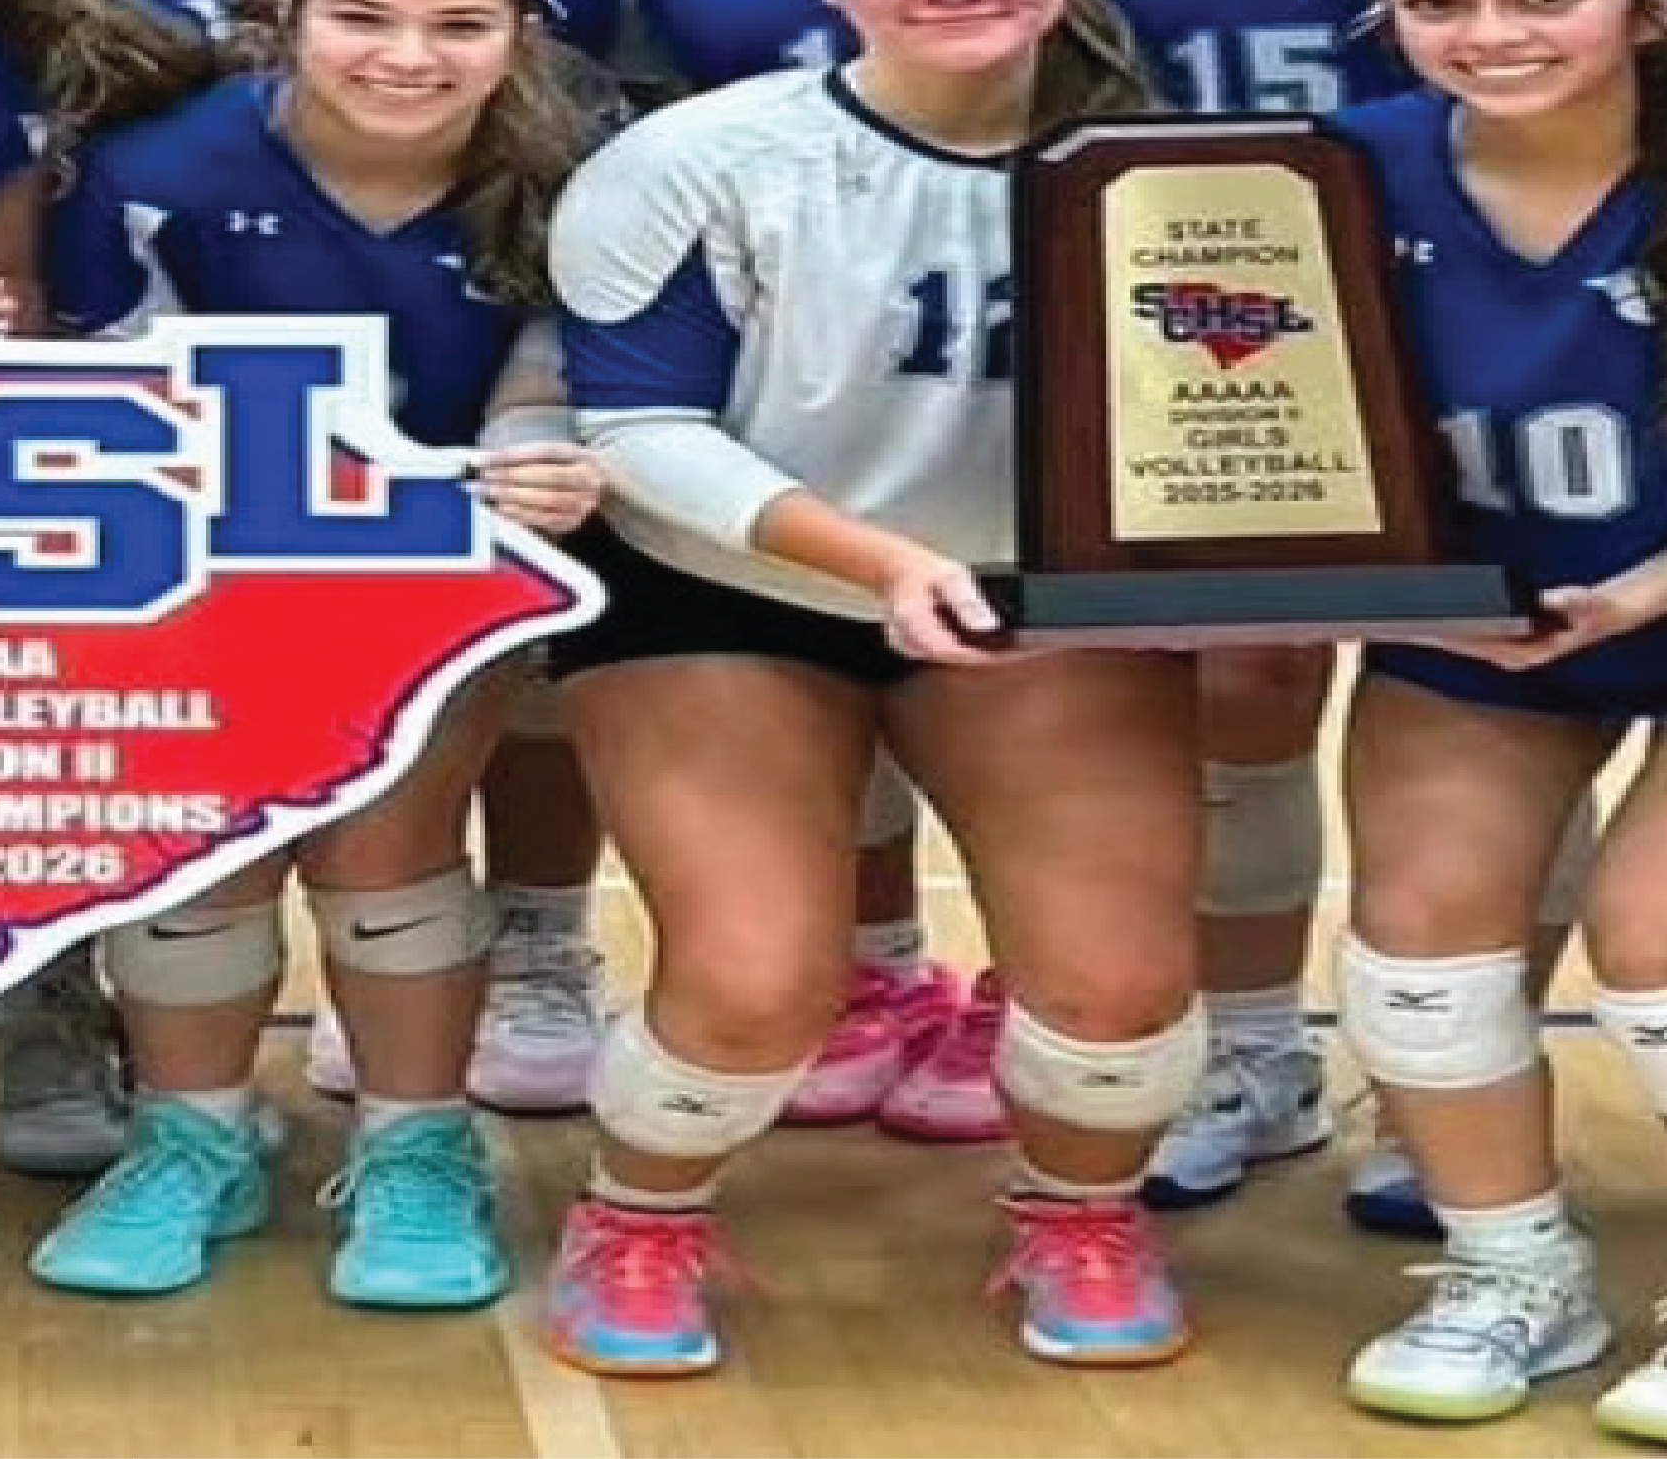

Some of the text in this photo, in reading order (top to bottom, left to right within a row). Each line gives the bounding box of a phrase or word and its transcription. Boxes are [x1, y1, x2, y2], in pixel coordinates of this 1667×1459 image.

[1175, 28, 1341, 112] 15
[1164, 219, 1261, 240] STATE
[1130, 247, 1299, 267] CHAMPION
[1184, 427, 1289, 449] GIRLS
[1127, 452, 1359, 477] VOLLEYBALL
[1437, 407, 1629, 517] 10
[74, 742, 116, 782] II
